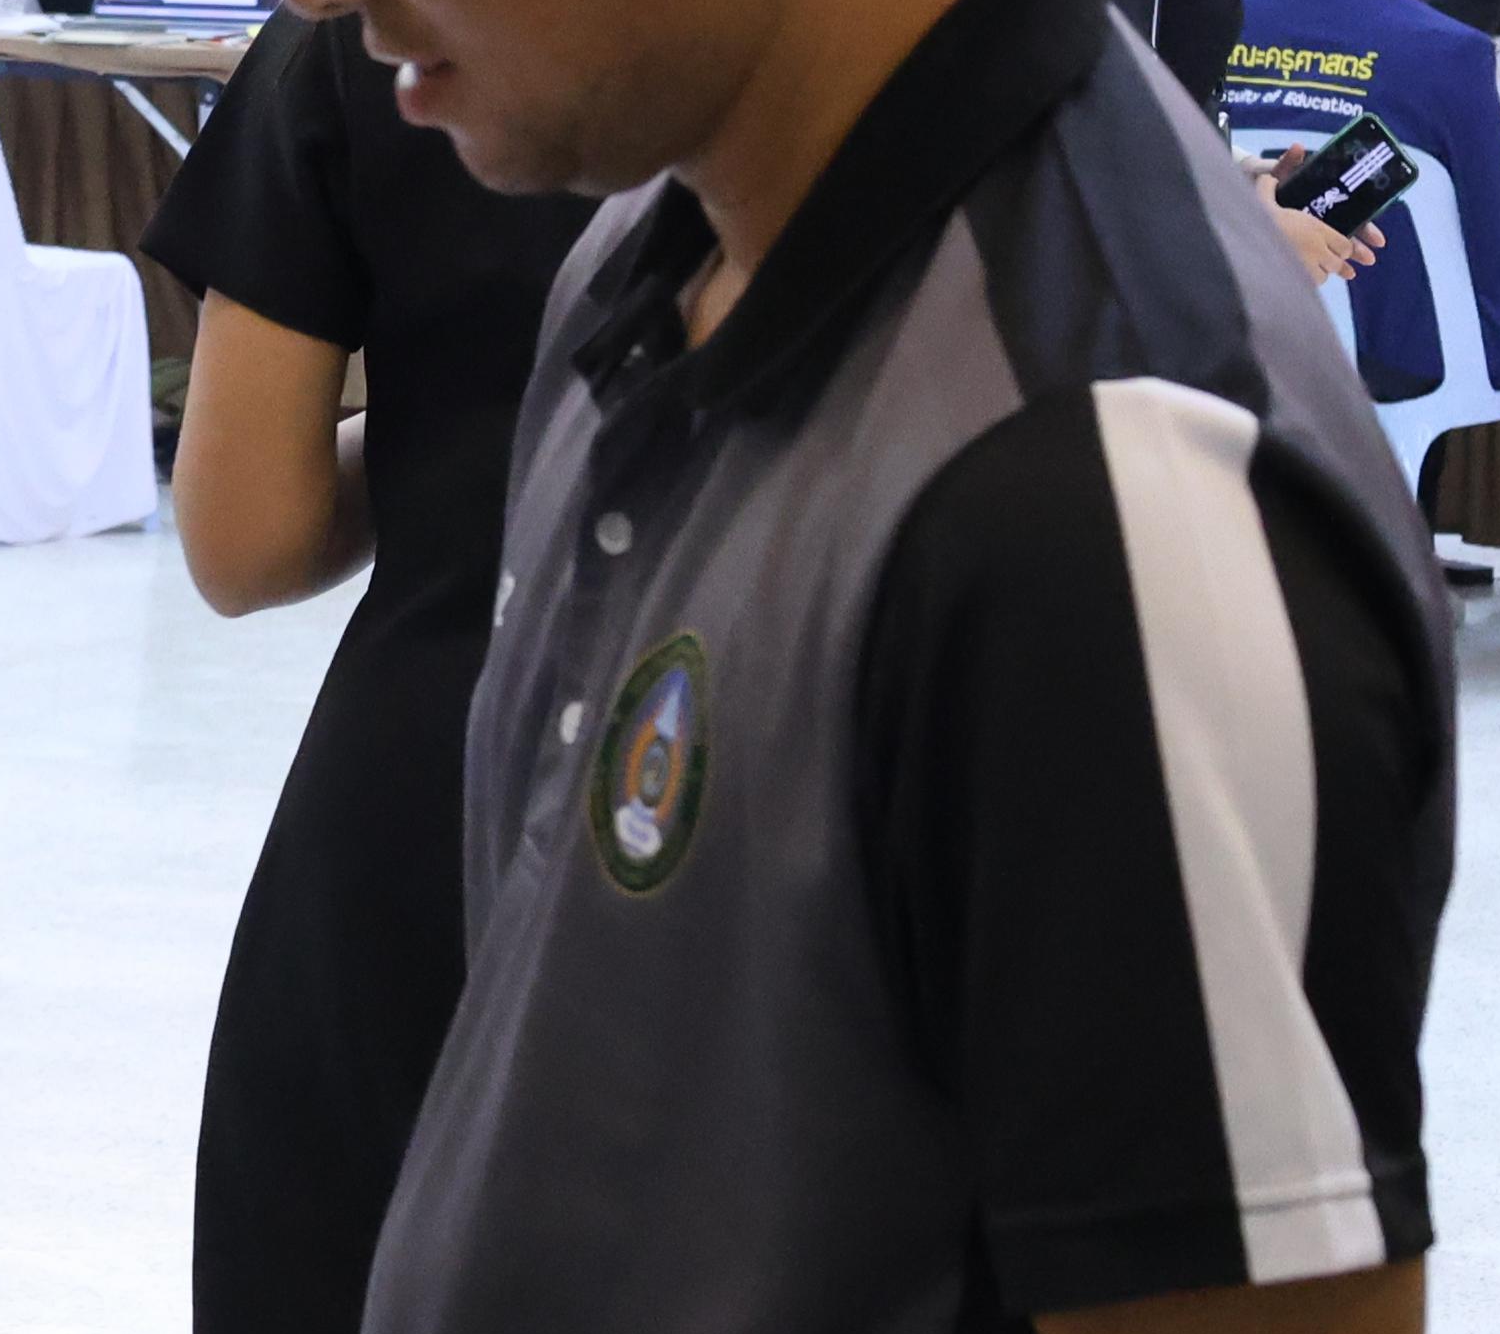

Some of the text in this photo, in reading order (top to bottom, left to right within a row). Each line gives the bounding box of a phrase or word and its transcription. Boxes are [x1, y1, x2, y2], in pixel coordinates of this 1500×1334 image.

[1227, 43, 1379, 81] ณะครุศาสตร์
[1262, 89, 1283, 104] of
[1283, 90, 1364, 117] Education
